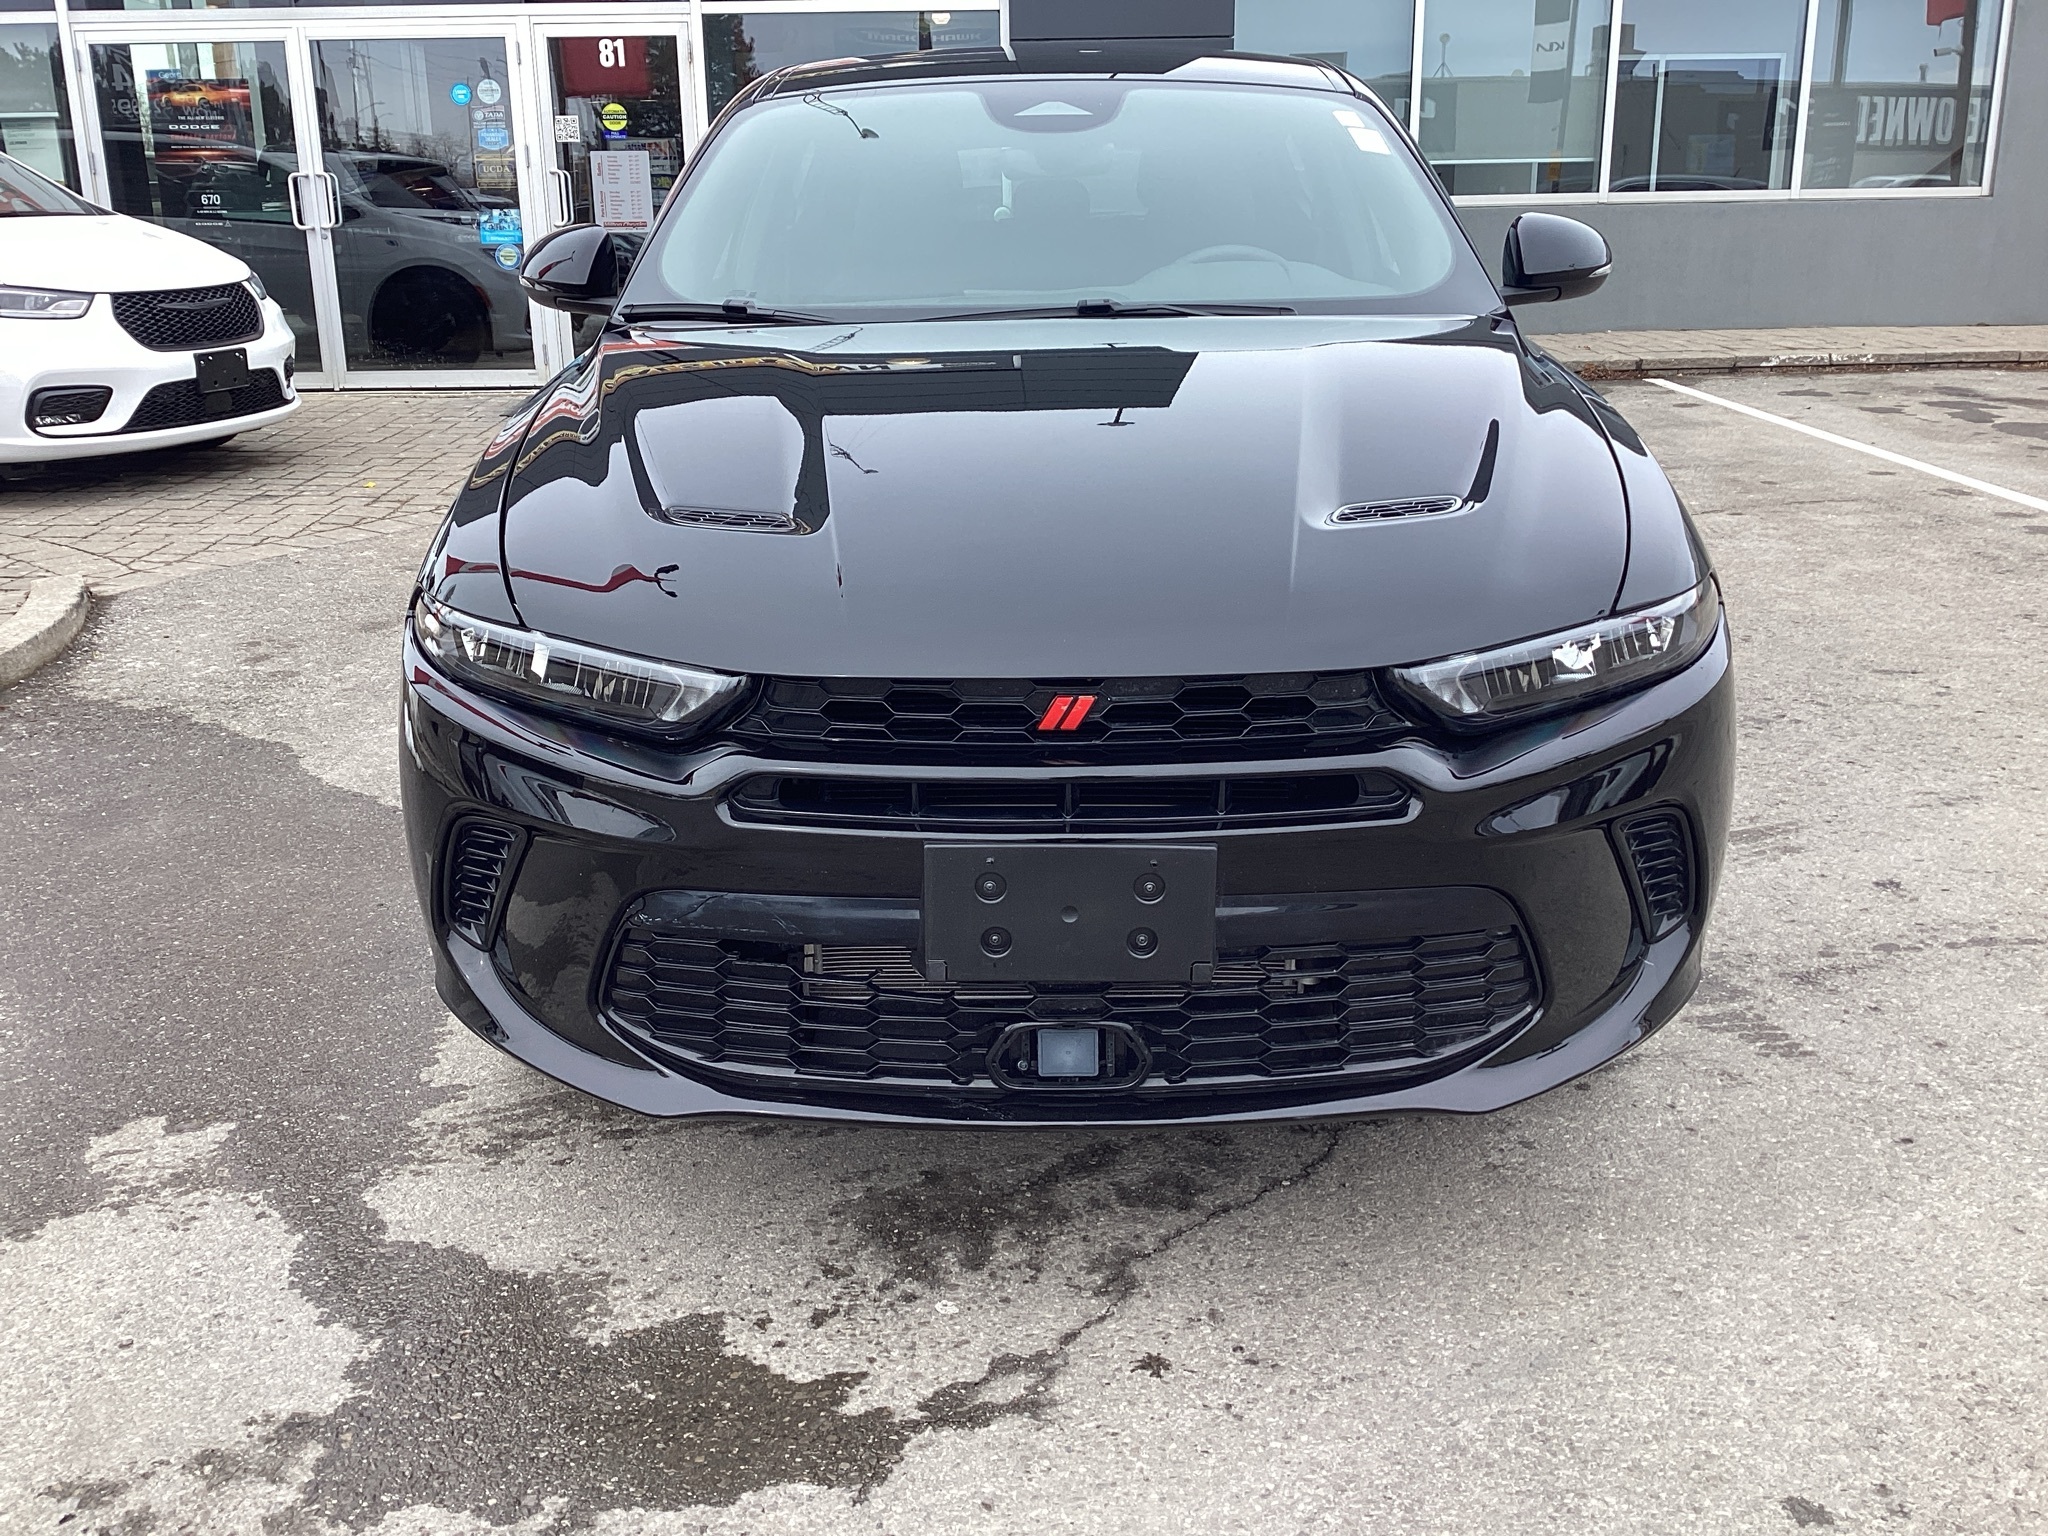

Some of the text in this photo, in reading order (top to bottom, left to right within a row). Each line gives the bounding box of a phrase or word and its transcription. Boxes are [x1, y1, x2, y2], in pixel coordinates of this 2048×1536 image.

[598, 38, 626, 68] 81
[483, 165, 511, 173] UCDA
[201, 194, 221, 205] 670
